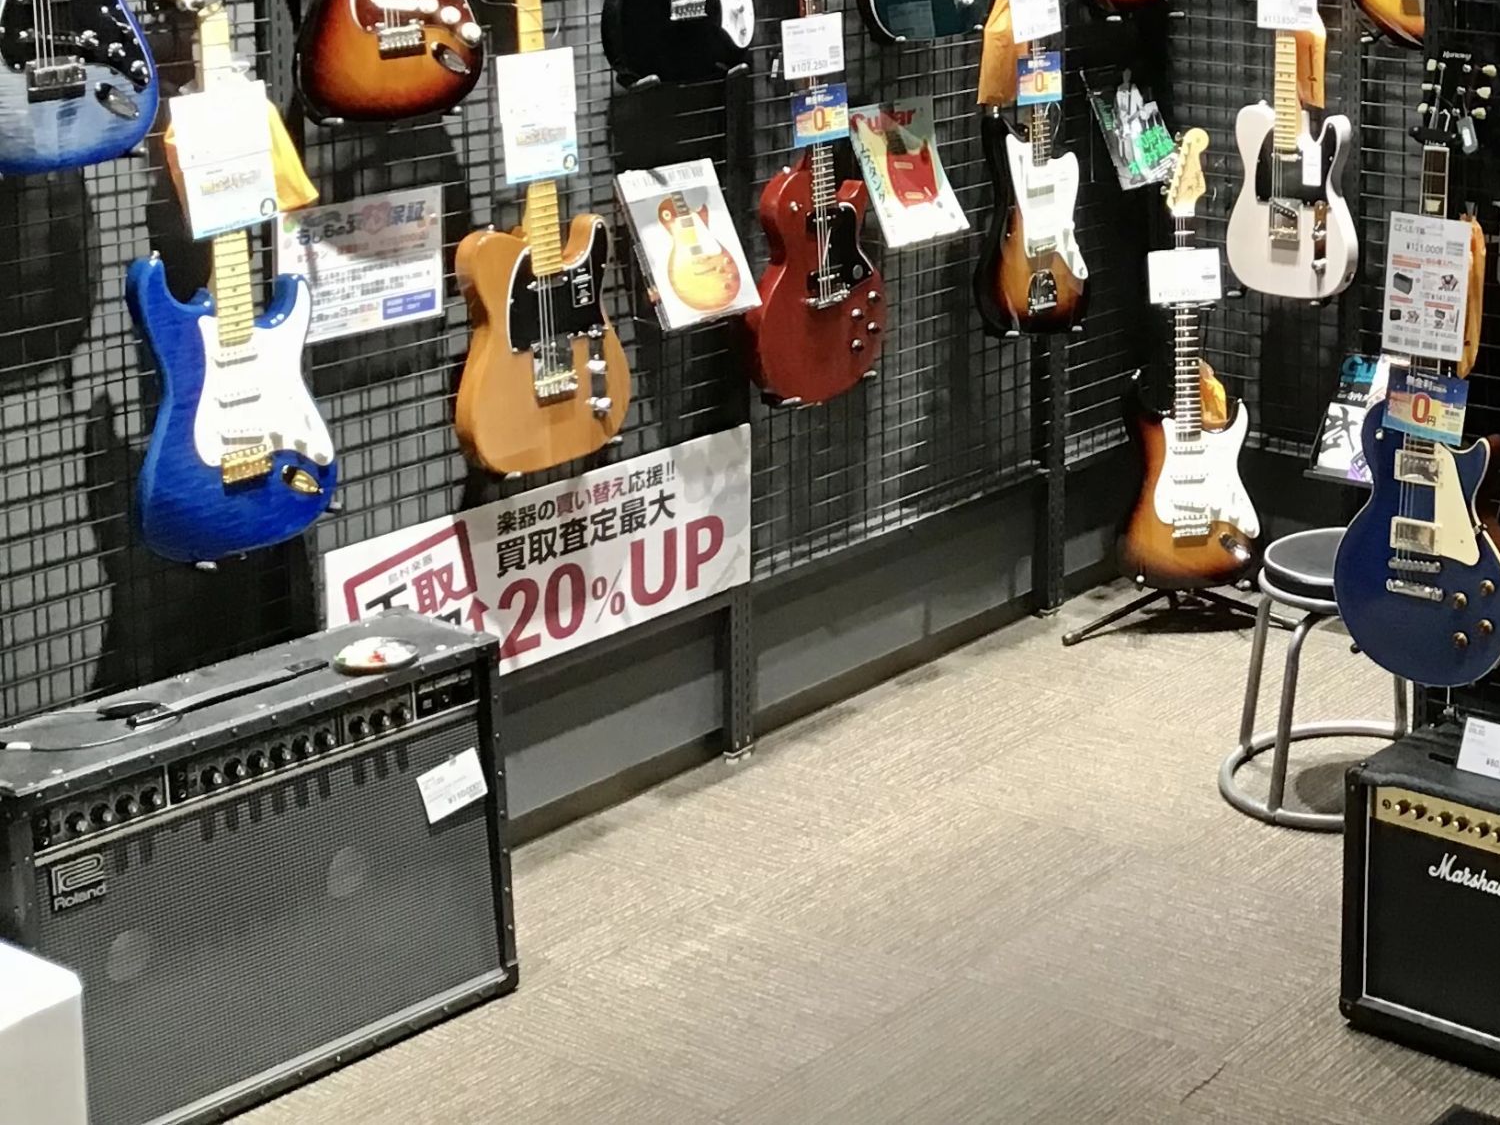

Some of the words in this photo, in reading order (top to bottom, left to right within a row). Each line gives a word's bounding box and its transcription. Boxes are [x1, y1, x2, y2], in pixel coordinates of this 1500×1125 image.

[496, 490, 676, 577] 買取査定最大
[53, 882, 107, 911] Roland
